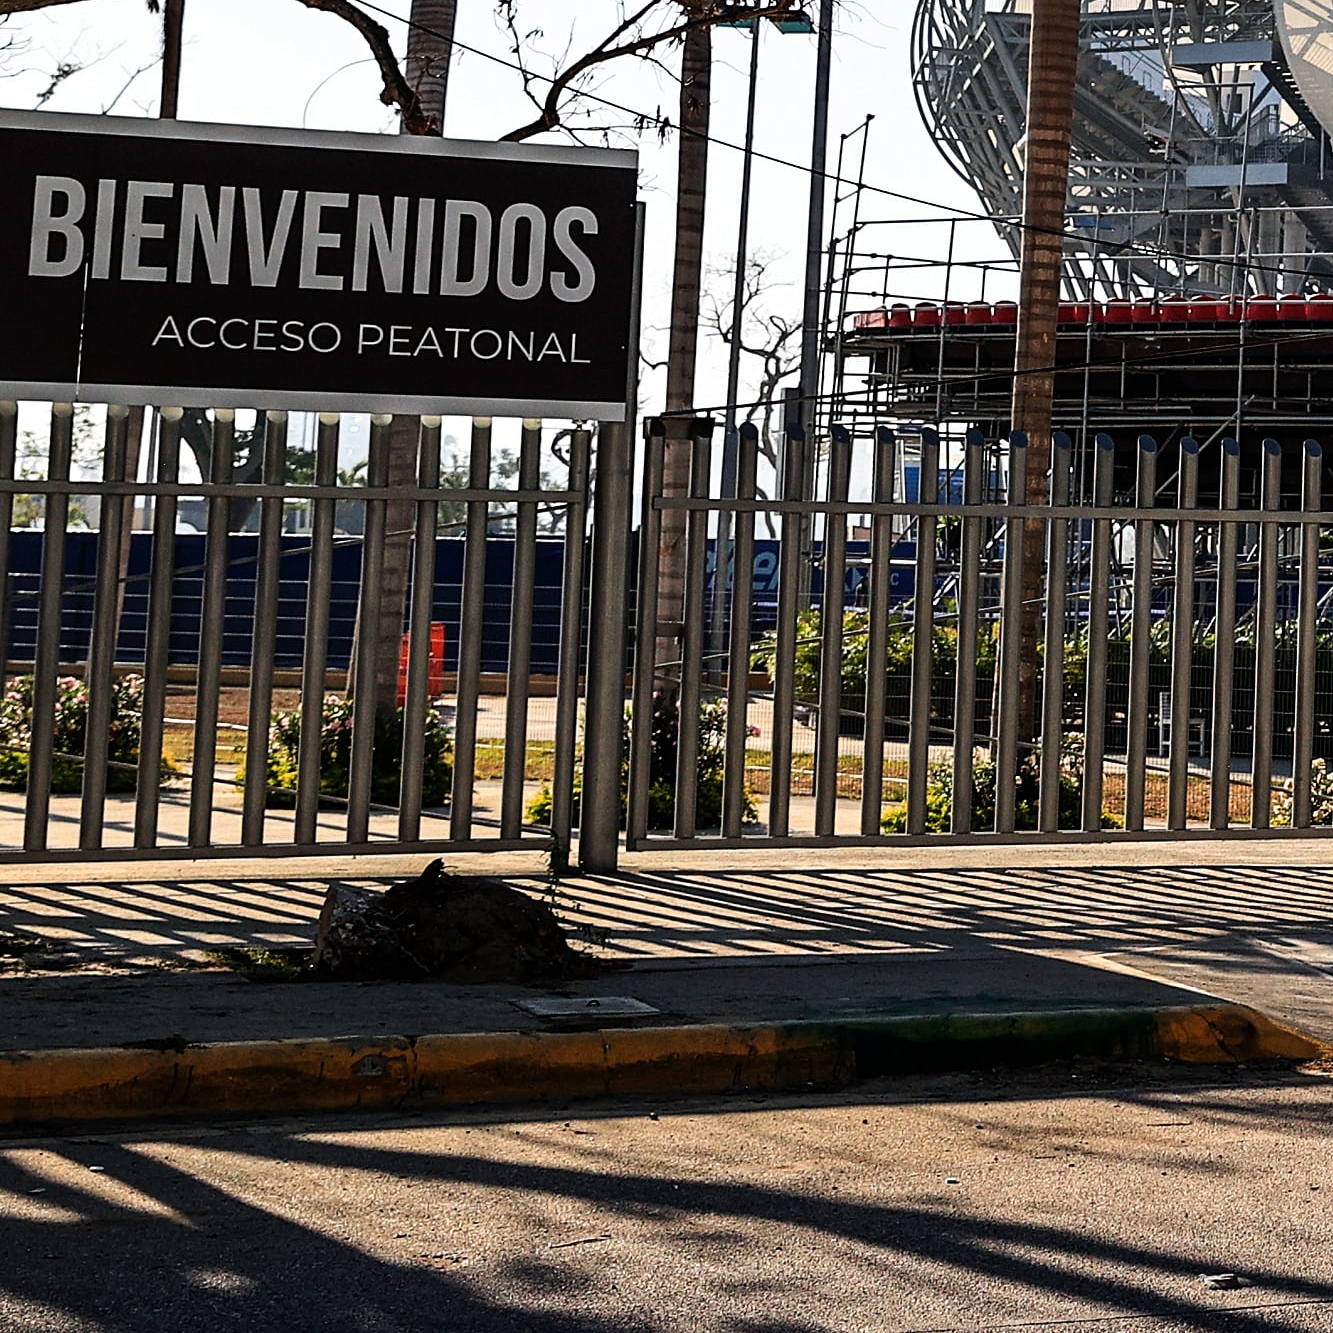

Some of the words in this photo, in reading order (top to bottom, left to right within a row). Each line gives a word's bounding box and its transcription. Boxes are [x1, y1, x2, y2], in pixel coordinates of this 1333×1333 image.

[27, 175, 599, 303] BIENVENIDOS
[151, 315, 342, 354] ACCESO
[357, 322, 592, 364] PEATONAL
